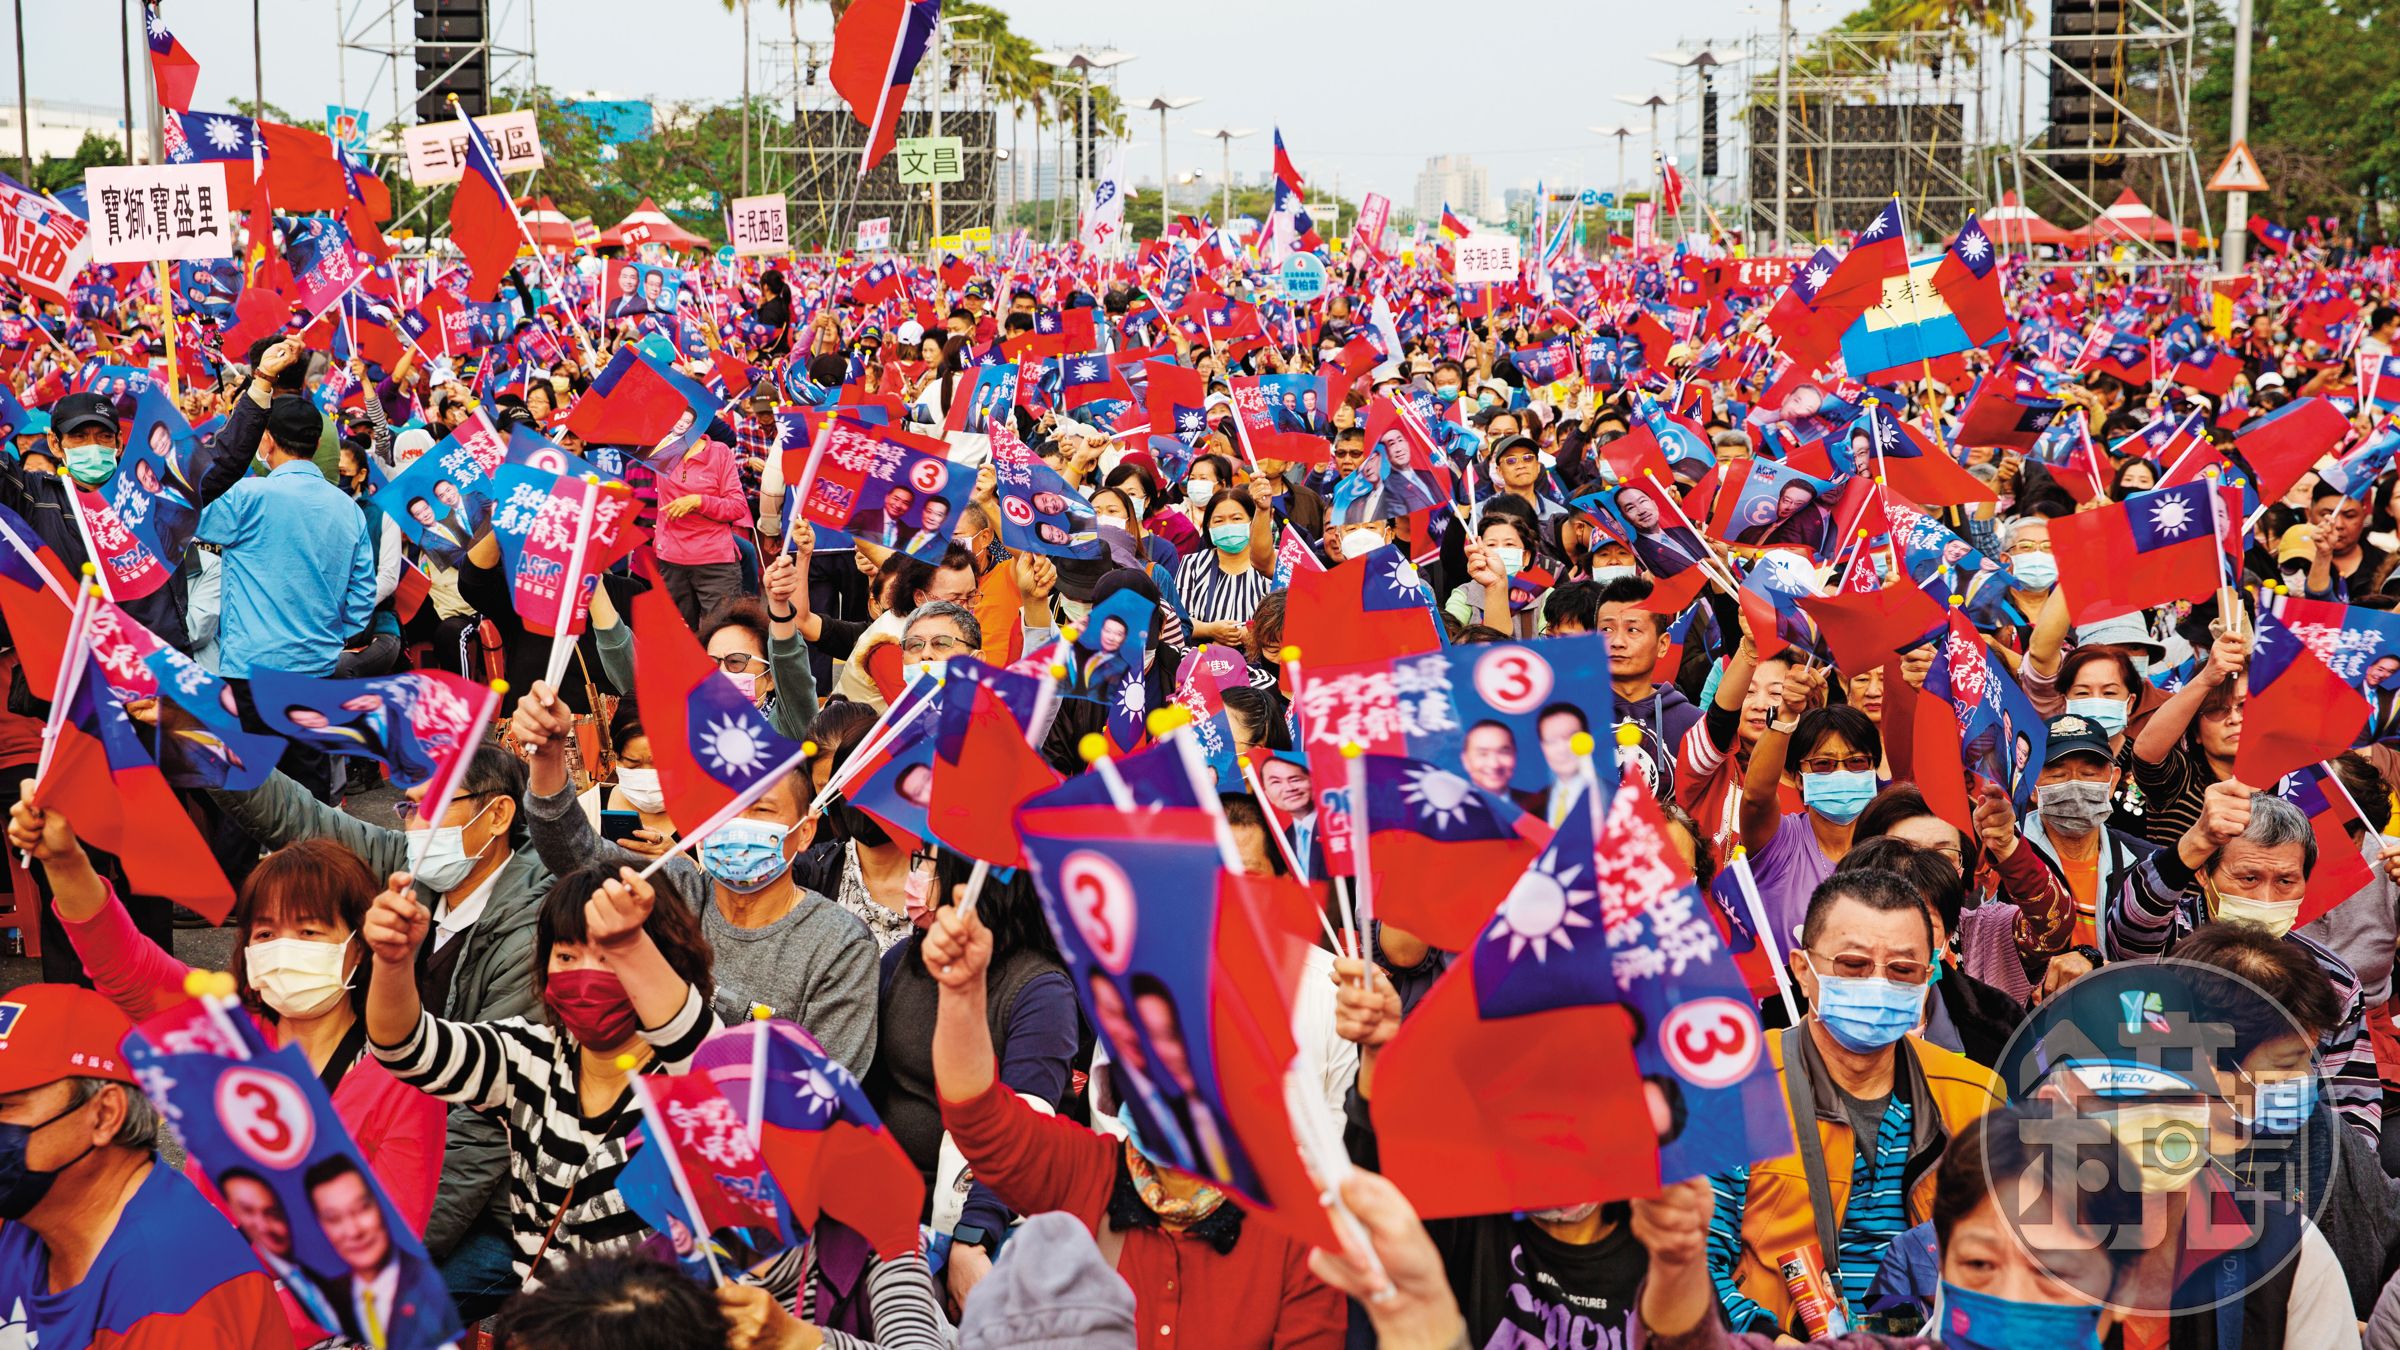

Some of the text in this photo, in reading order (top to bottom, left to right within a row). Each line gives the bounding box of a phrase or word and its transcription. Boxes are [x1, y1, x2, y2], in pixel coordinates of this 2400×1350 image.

[901, 147, 958, 176] 文昌
[738, 208, 784, 244] 三民西區
[1463, 247, 1512, 272] 苓雅8里
[1659, 435, 1682, 462] 3
[918, 464, 939, 489] 3
[1206, 659, 1232, 671] 佳琪
[1496, 657, 1532, 703] 3
[1075, 872, 1115, 954] 3
[1674, 1014, 1747, 1067] 3
[2099, 1070, 2154, 1085] KHEDU
[235, 1081, 291, 1153] 3
[1568, 1294, 1608, 1310] PICTURES
